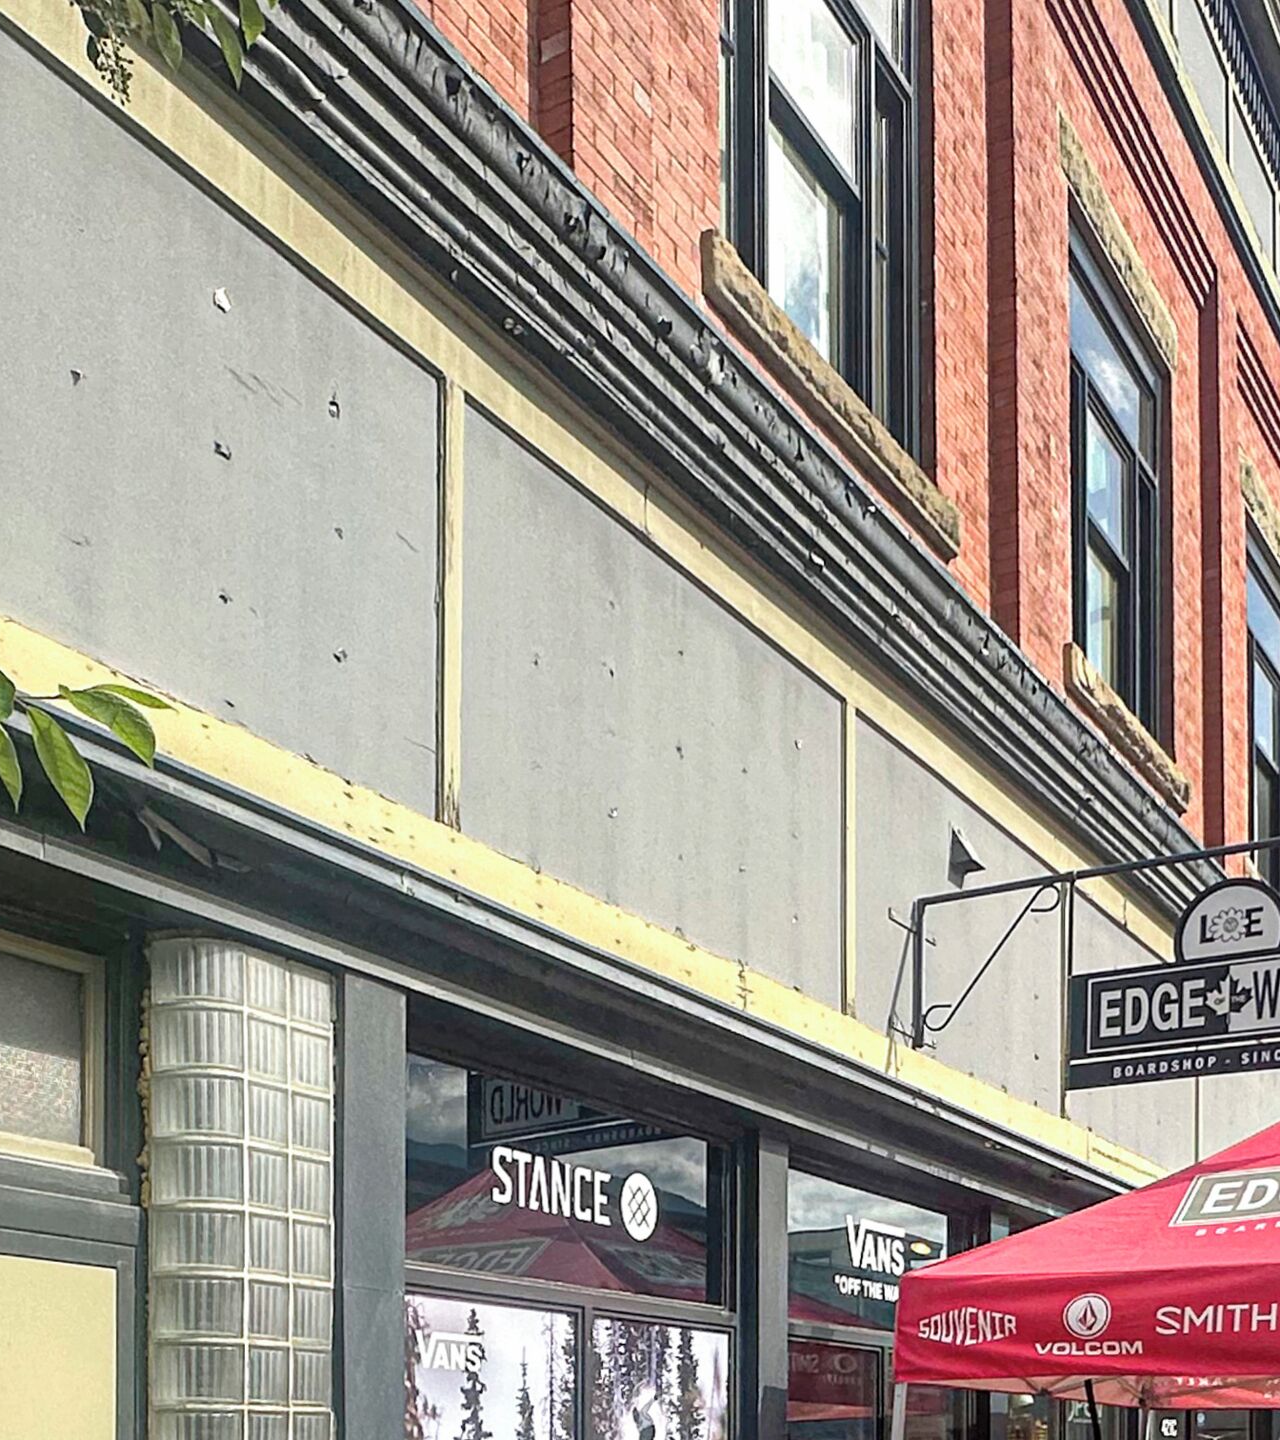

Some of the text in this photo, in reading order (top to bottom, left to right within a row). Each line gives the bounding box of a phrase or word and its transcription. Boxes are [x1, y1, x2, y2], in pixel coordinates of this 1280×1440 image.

[1099, 978, 1206, 1038] EDGE
[1112, 1055, 1218, 1079] BOARDSHOP
[491, 1145, 612, 1226] STANCE
[845, 1213, 906, 1277] VANS
[862, 1280, 884, 1300] THE
[918, 1306, 1018, 1346] SOUVENIR
[1155, 1302, 1279, 1336] SMITH
[416, 1330, 483, 1373] VANS
[1034, 1339, 1144, 1356] VOLCOM
